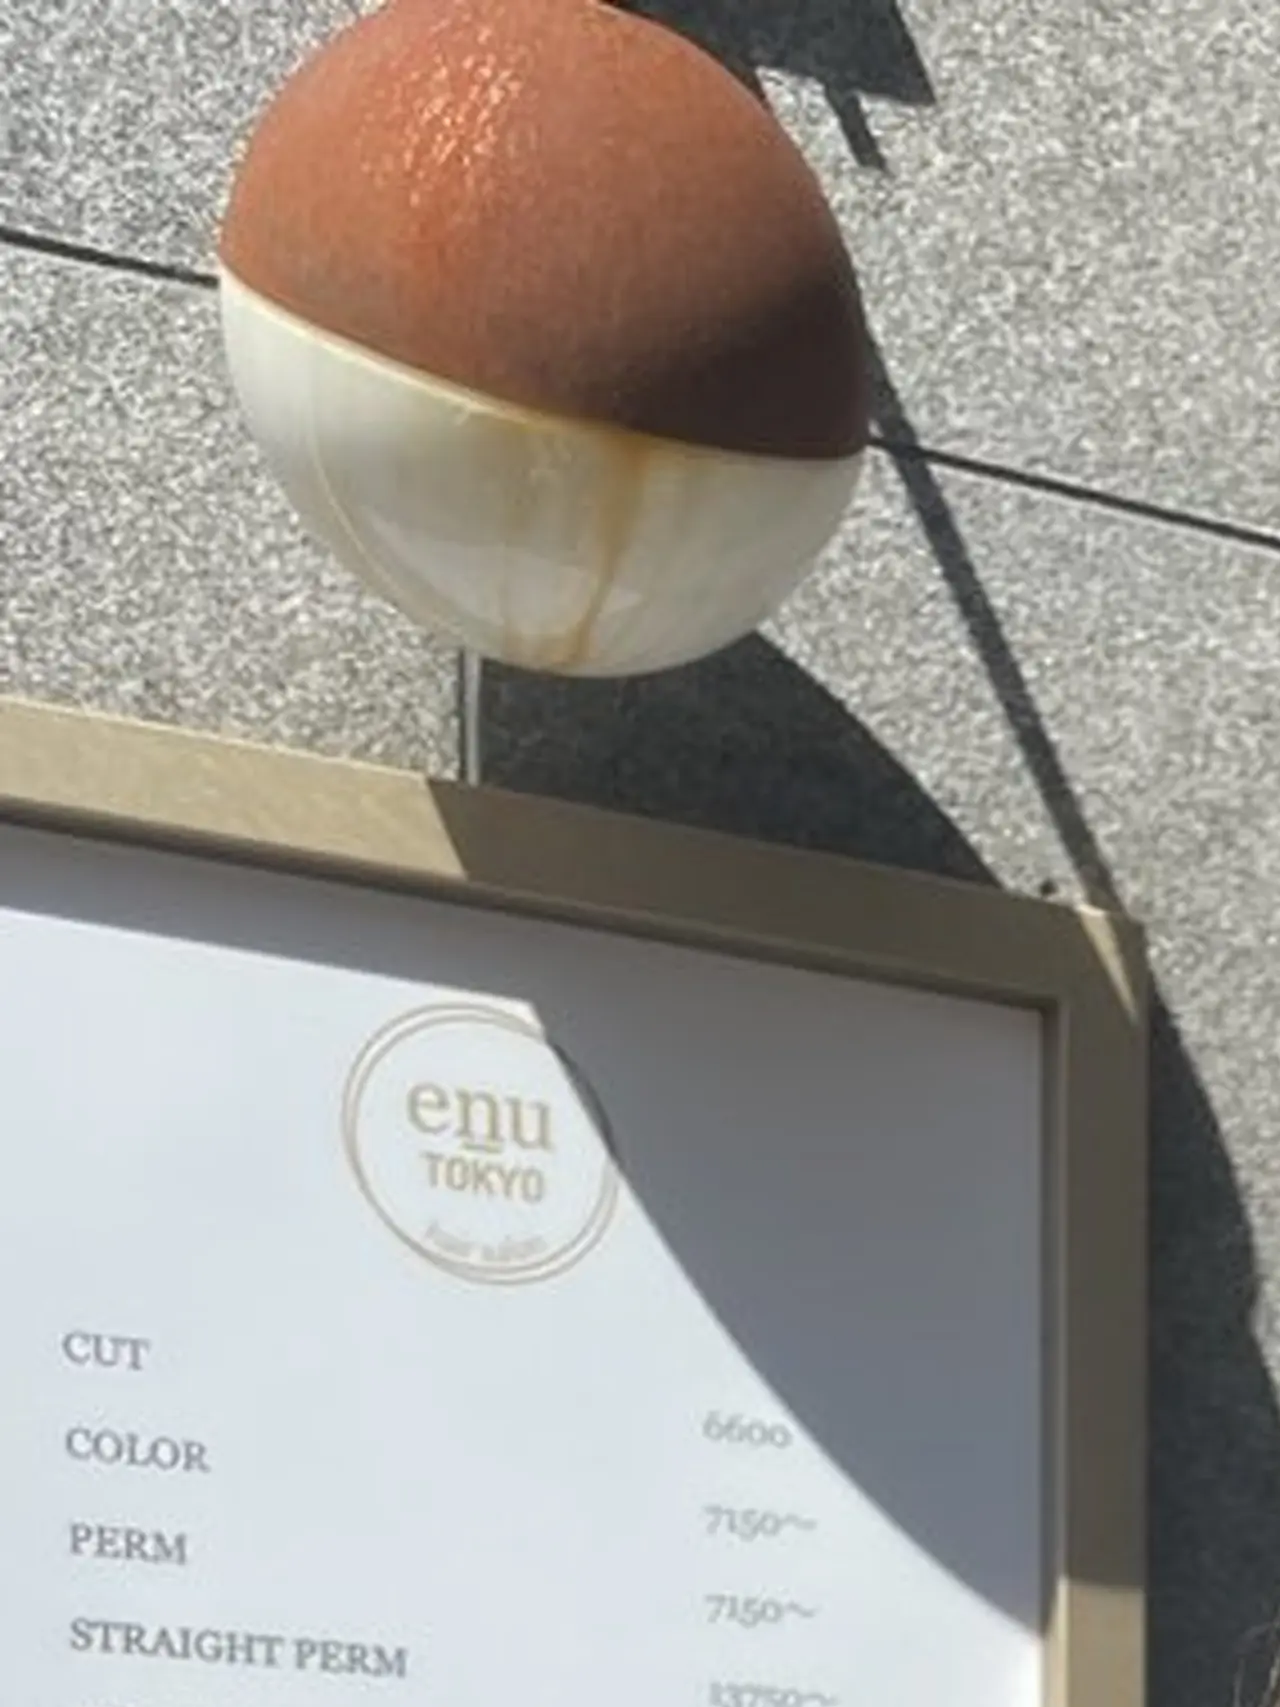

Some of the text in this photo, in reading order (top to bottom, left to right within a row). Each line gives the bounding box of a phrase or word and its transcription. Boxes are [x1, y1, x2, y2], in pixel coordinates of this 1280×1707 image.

[406, 1082, 553, 1154] enu
[421, 1151, 544, 1205] TOKYO
[61, 1330, 151, 1372] CUT
[65, 1424, 210, 1474] COLOR
[703, 1411, 792, 1449] 6600
[69, 1521, 189, 1567] PERM
[69, 1616, 409, 1680] STRAIGHT PERM
